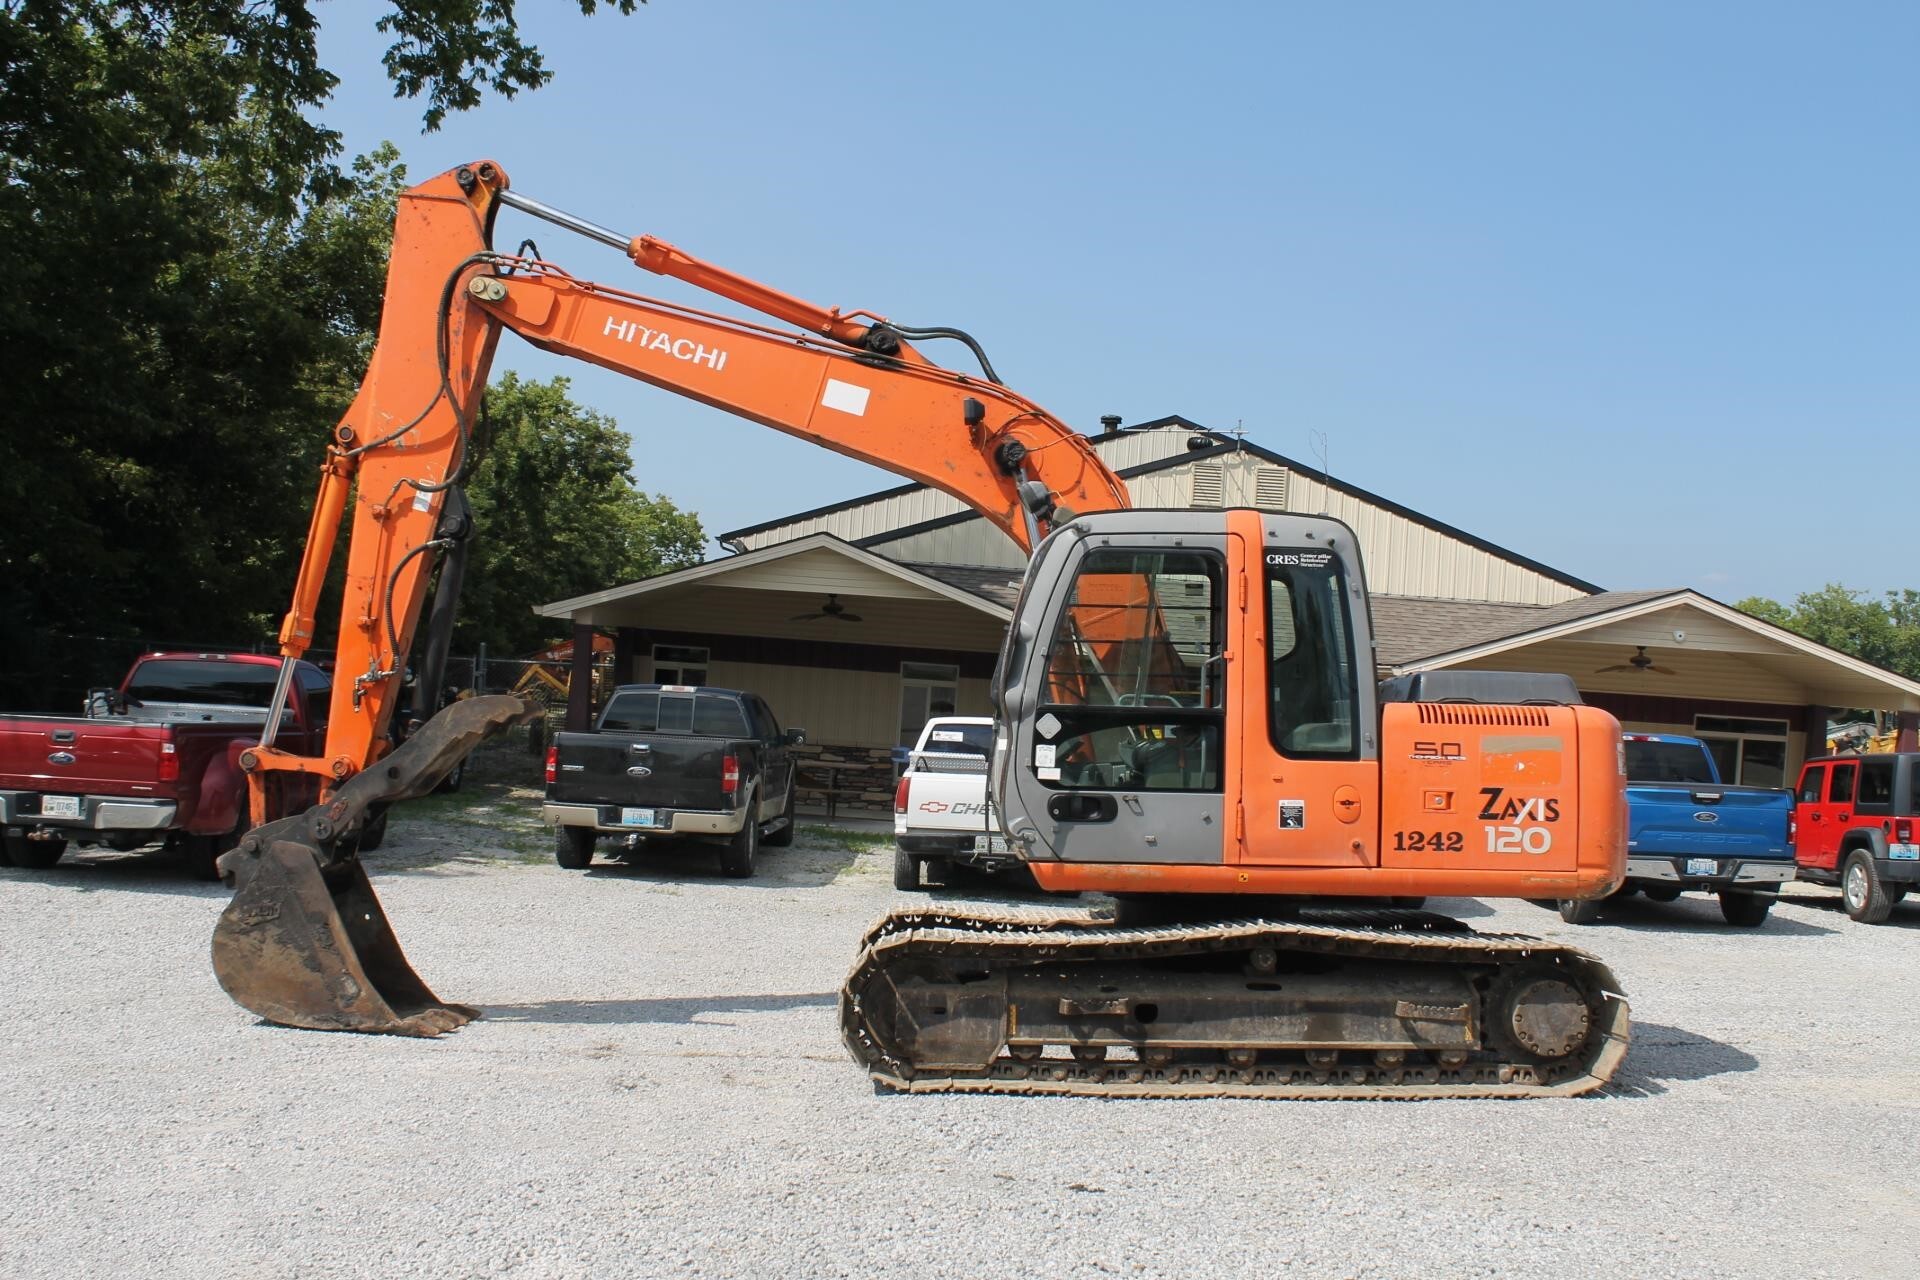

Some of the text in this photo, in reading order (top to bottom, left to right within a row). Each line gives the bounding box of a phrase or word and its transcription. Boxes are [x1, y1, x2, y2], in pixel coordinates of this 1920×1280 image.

[602, 315, 728, 372] HITACHI
[1266, 554, 1299, 565] CRES
[1414, 741, 1461, 757] 50
[1477, 787, 1560, 825] ZAXIS
[1393, 830, 1464, 852] 1242
[1484, 825, 1552, 854] 120
